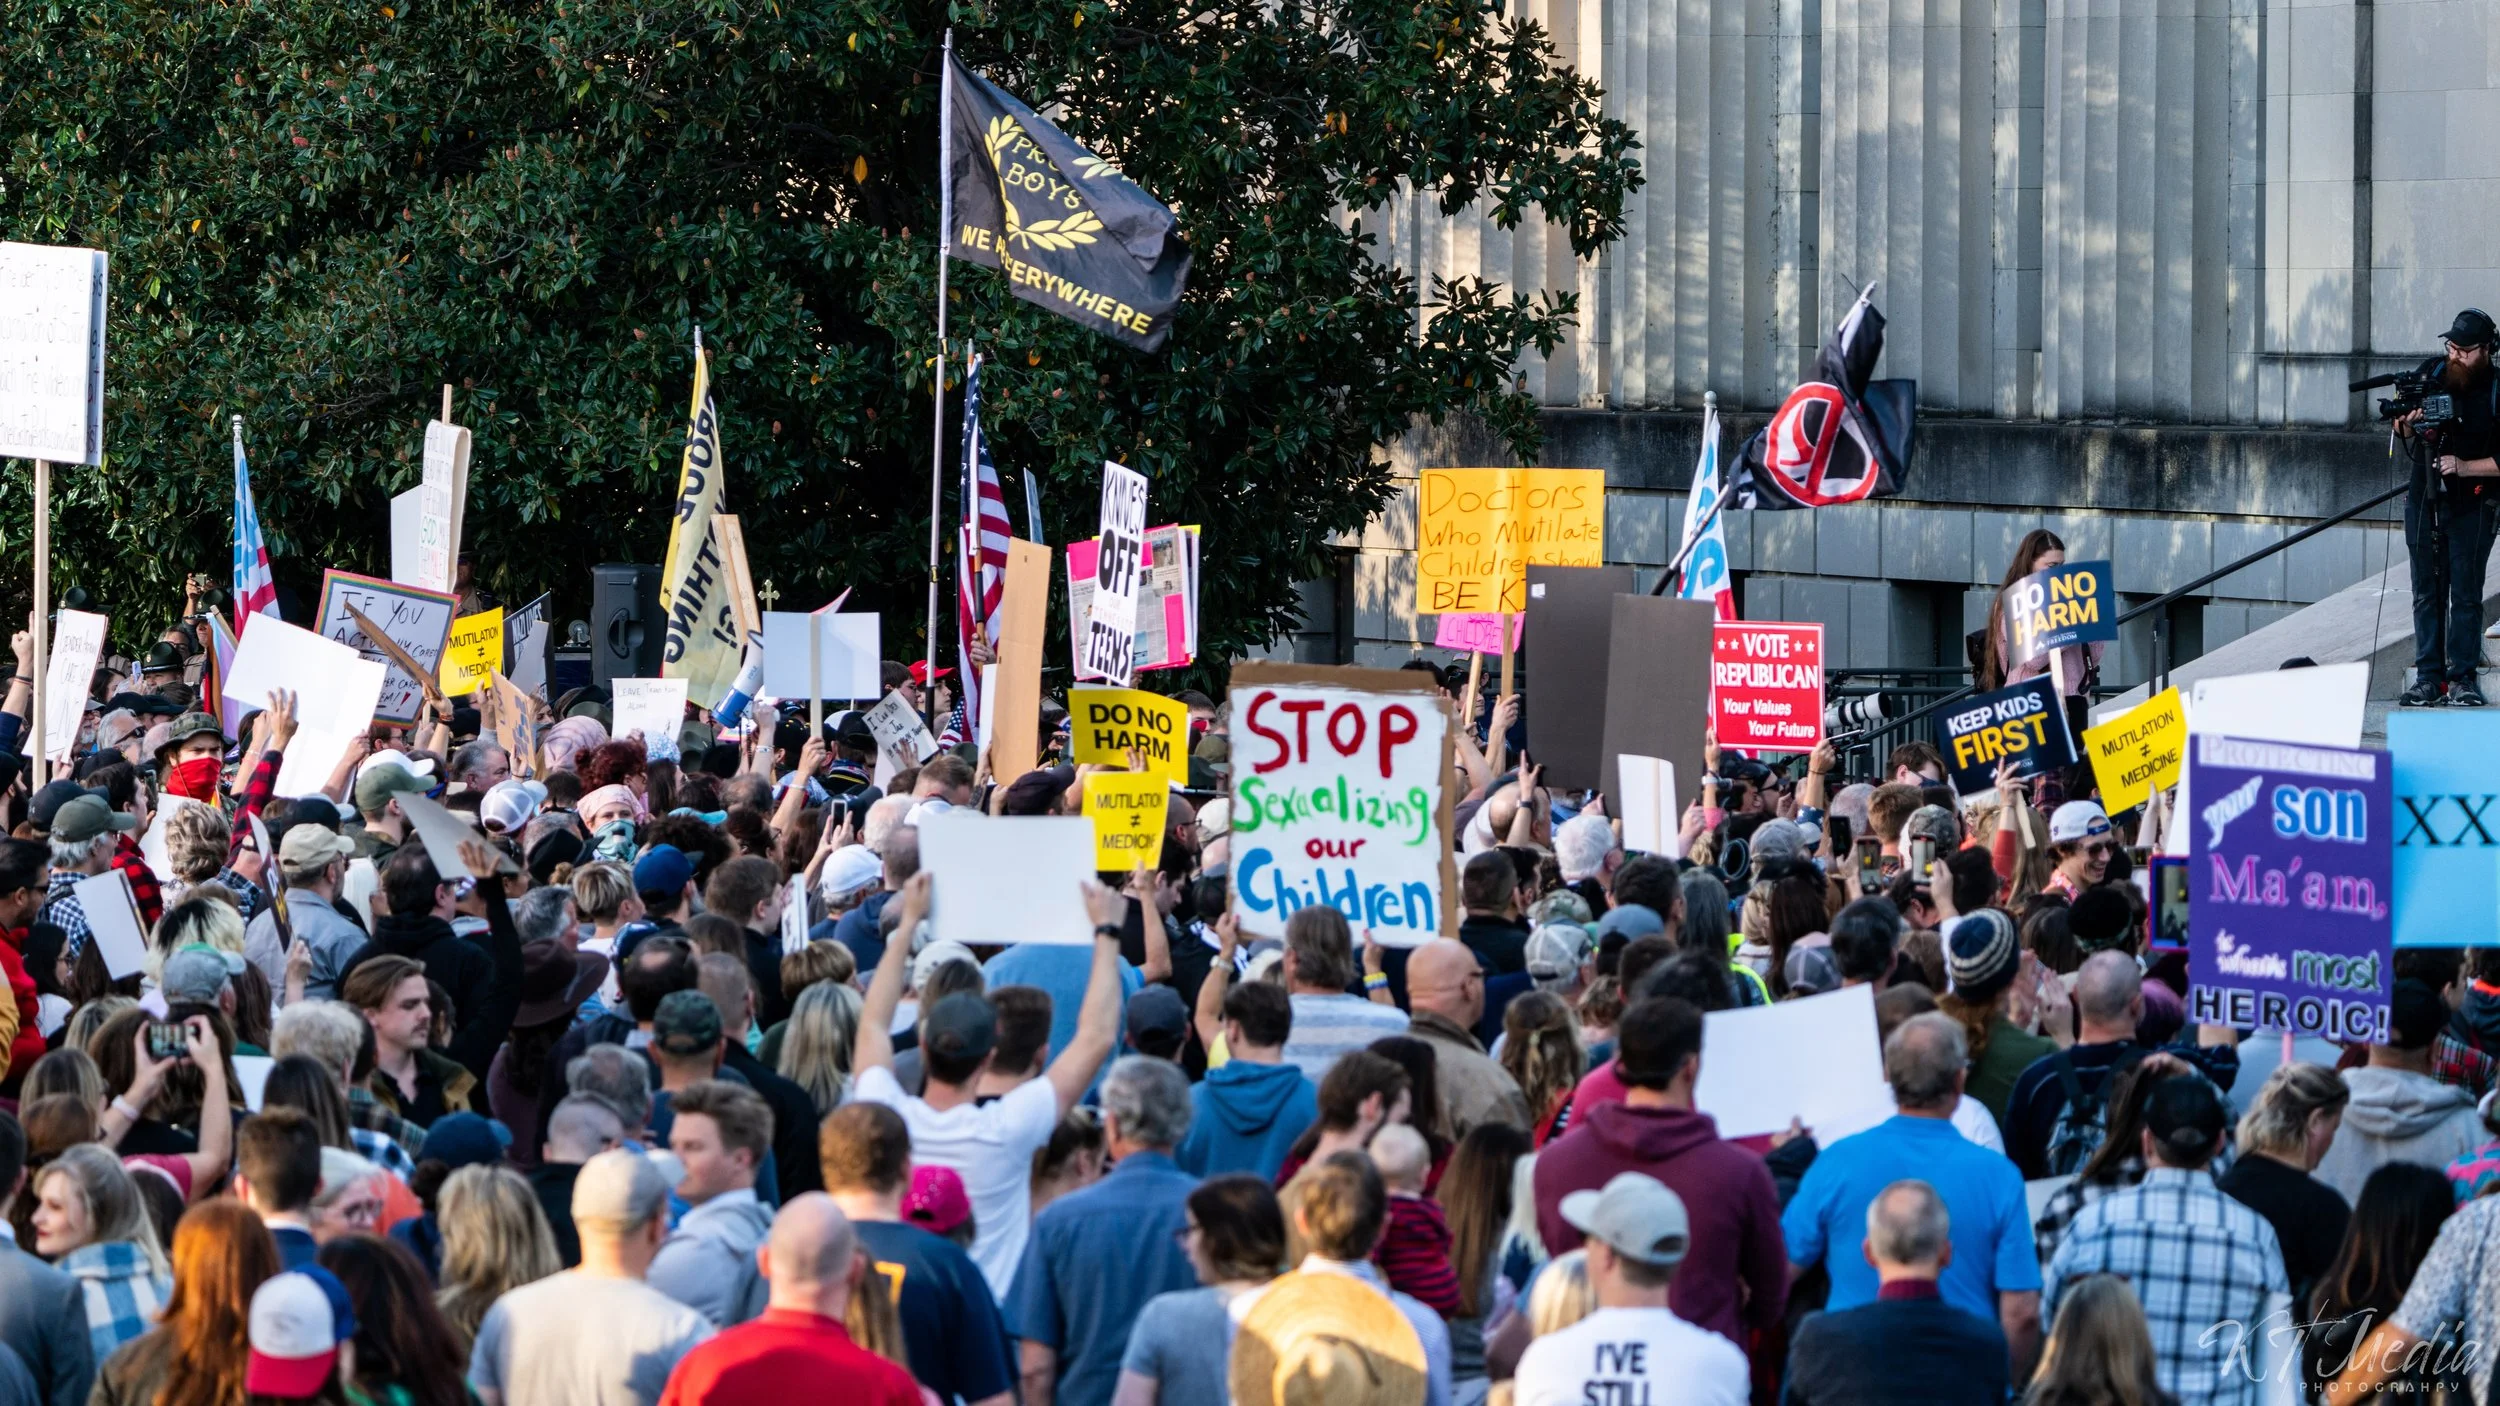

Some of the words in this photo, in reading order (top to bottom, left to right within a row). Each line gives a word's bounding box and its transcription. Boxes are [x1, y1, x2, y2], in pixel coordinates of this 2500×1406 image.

[1004, 162, 1082, 209] BOYS
[961, 224, 991, 251] WE
[1428, 474, 1586, 517] Doctors
[1424, 520, 1481, 547] Who
[1495, 513, 1600, 545] Mutilate
[1099, 528, 1139, 598] OFF
[1421, 550, 1536, 578] Children
[337, 591, 375, 621] IF
[382, 600, 424, 633] YOU
[1433, 581, 1480, 610] BE
[2010, 583, 2044, 622] DO
[2050, 571, 2097, 601] NO
[449, 625, 499, 649] MUTILATION
[2013, 598, 2099, 646] HARM
[1089, 620, 1132, 681] TEENS
[1742, 633, 1790, 659] VOTE
[1715, 662, 1818, 689] REPUBLICAN
[1089, 703, 1133, 725] DO
[1137, 706, 1172, 735] NO
[1723, 698, 1750, 716] Your
[1753, 699, 1792, 717] Values
[1947, 704, 1994, 737] KEEP
[1993, 691, 2044, 722] KIDS
[1094, 729, 1170, 763] HARM
[1246, 690, 1418, 779] STOP
[1748, 720, 1776, 737] Your
[1777, 721, 1816, 739] Future
[1952, 712, 2049, 771] FIRST
[2101, 709, 2175, 759] MUTILATION
[2121, 748, 2179, 789] MEDICINE
[1232, 774, 1429, 847] Sexualizing
[2272, 784, 2368, 845] son
[1305, 837, 1367, 859] our
[1237, 848, 1435, 932] Children
[2292, 949, 2382, 994] most
[2192, 983, 2391, 1044] HEROIC!
[1595, 1343, 1648, 1375] I'VE
